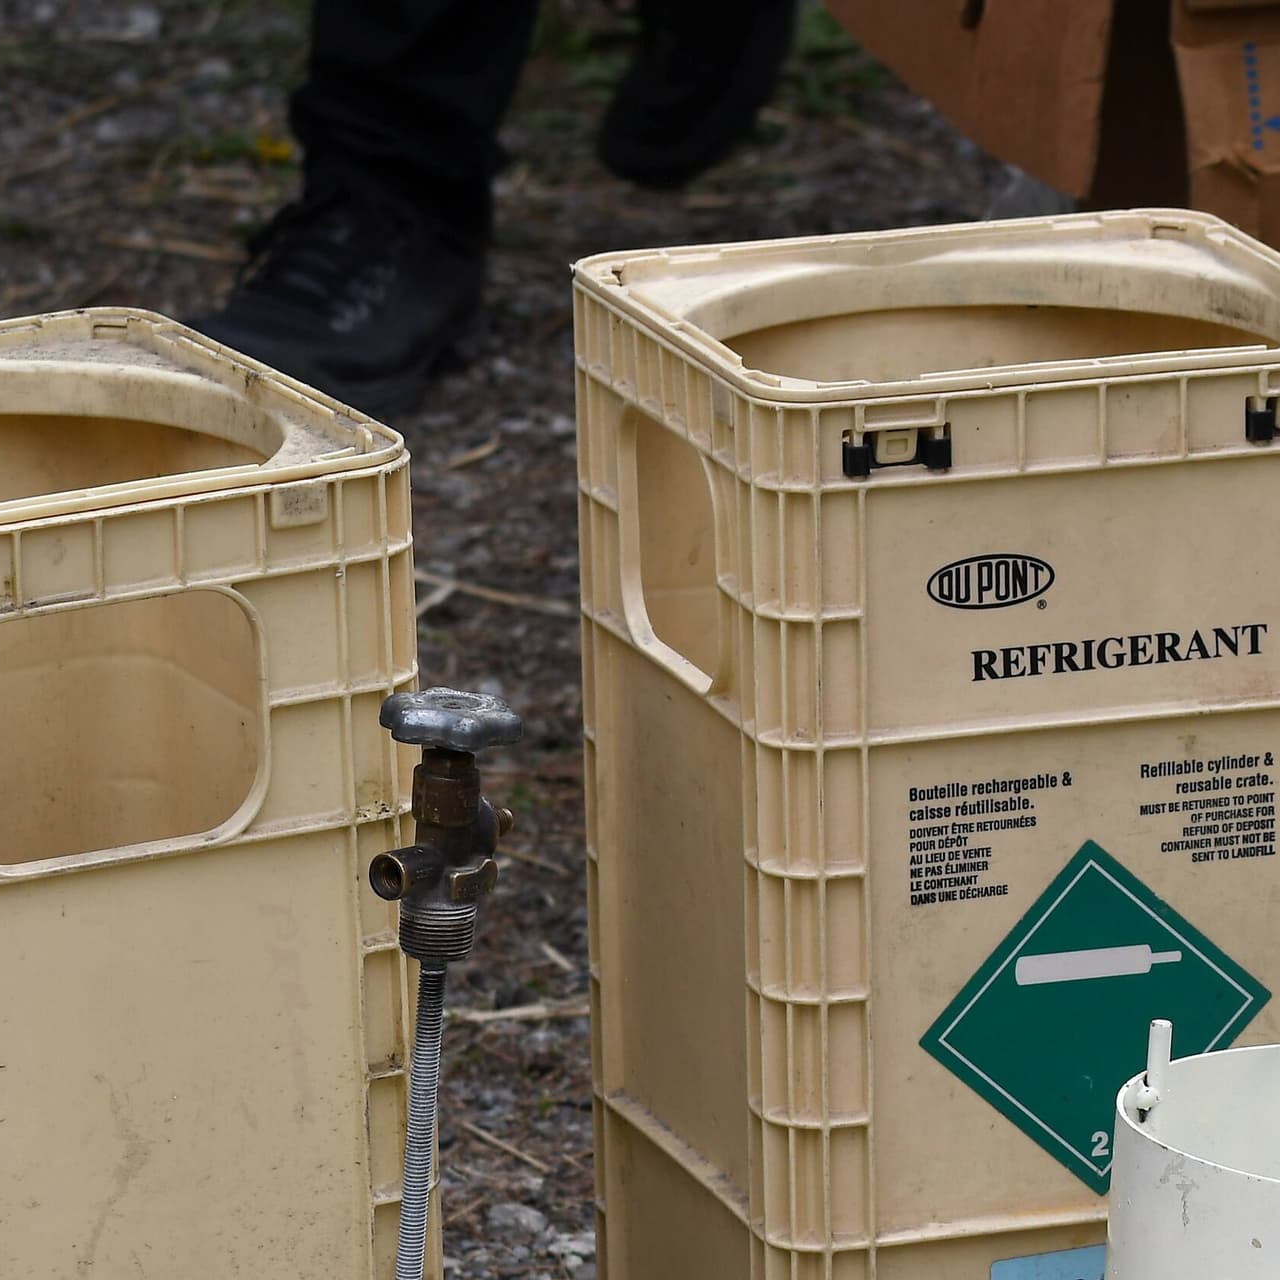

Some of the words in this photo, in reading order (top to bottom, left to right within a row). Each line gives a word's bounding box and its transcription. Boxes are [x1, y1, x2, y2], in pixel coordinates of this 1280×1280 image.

[971, 624, 1267, 681] REFRIGERANT
[1140, 760, 1204, 779] Refillable
[1207, 754, 1260, 774] cylinder
[1264, 752, 1274, 766] &
[909, 783, 968, 802] Bouteille
[972, 774, 1058, 795] rechargeable
[1062, 771, 1072, 786] &
[1176, 776, 1232, 794] reusable
[1236, 773, 1274, 788] crate.
[910, 805, 951, 821] caisse
[955, 797, 1034, 817] réutilisable.
[1140, 803, 1166, 816] MUST
[1168, 802, 1180, 813] BE
[1182, 797, 1230, 811] RETURNED
[1233, 796, 1245, 805] TO
[1247, 793, 1275, 805] POINT
[1191, 813, 1203, 823] OF
[1205, 808, 1253, 822] PURCHASE
[1256, 806, 1275, 817] FOR
[910, 825, 949, 839] DOIVENT
[951, 822, 974, 835] ÊTRE
[976, 815, 1036, 832] RETOURNÉES
[1183, 824, 1219, 837] REFUND
[1222, 823, 1234, 833] OF
[1236, 819, 1275, 832] DEPOSIT
[910, 841, 936, 852] POUR
[938, 835, 968, 848] DÉPÔT
[1161, 839, 1211, 853] CONTAINER
[1214, 835, 1240, 847] MUST
[1242, 833, 1261, 844] NOT
[1263, 832, 1276, 842] BE
[910, 855, 923, 865] AU
[926, 852, 946, 864] LIEU
[948, 851, 960, 861] DE
[962, 847, 991, 860] VENTE
[1192, 851, 1214, 862] SENT
[1218, 850, 1229, 860] TO
[1232, 845, 1276, 858] LANDFILL
[910, 868, 923, 879] NE
[925, 866, 942, 877] PAS
[945, 861, 988, 874] ÉLIMINER
[910, 881, 922, 892] LE
[924, 875, 978, 890] CONTENANT
[911, 894, 936, 906] DANS
[939, 890, 957, 902] UNE
[959, 885, 1008, 900] DÉCHARGE
[1091, 1131, 1109, 1157] 2
